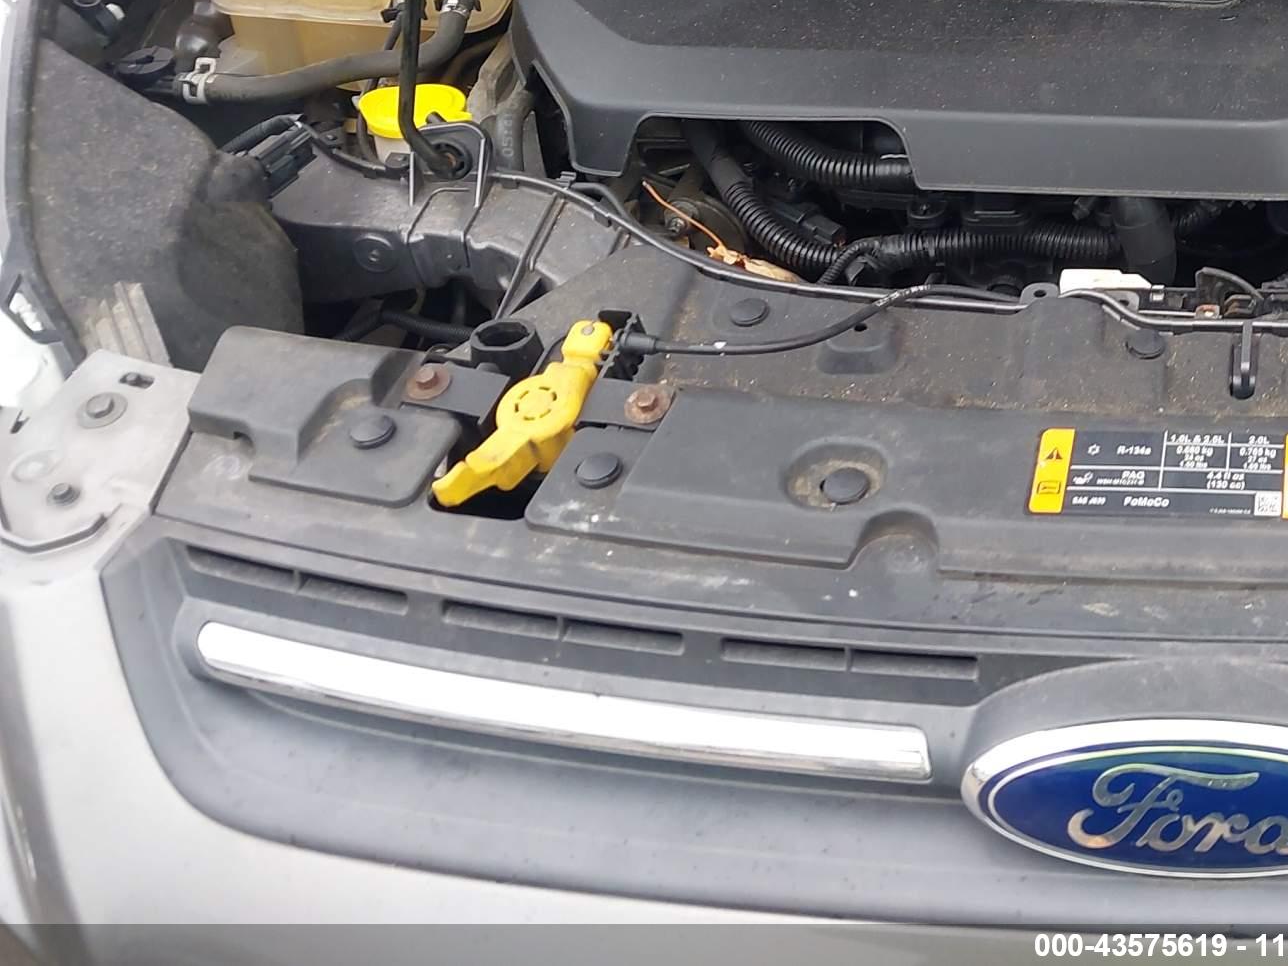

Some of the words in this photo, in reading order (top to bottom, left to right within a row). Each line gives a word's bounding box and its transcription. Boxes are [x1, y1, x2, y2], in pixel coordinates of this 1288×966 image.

[1116, 445, 1152, 456] R-134a
[1121, 470, 1146, 480] PAG
[1123, 496, 1171, 508] FoMoCo
